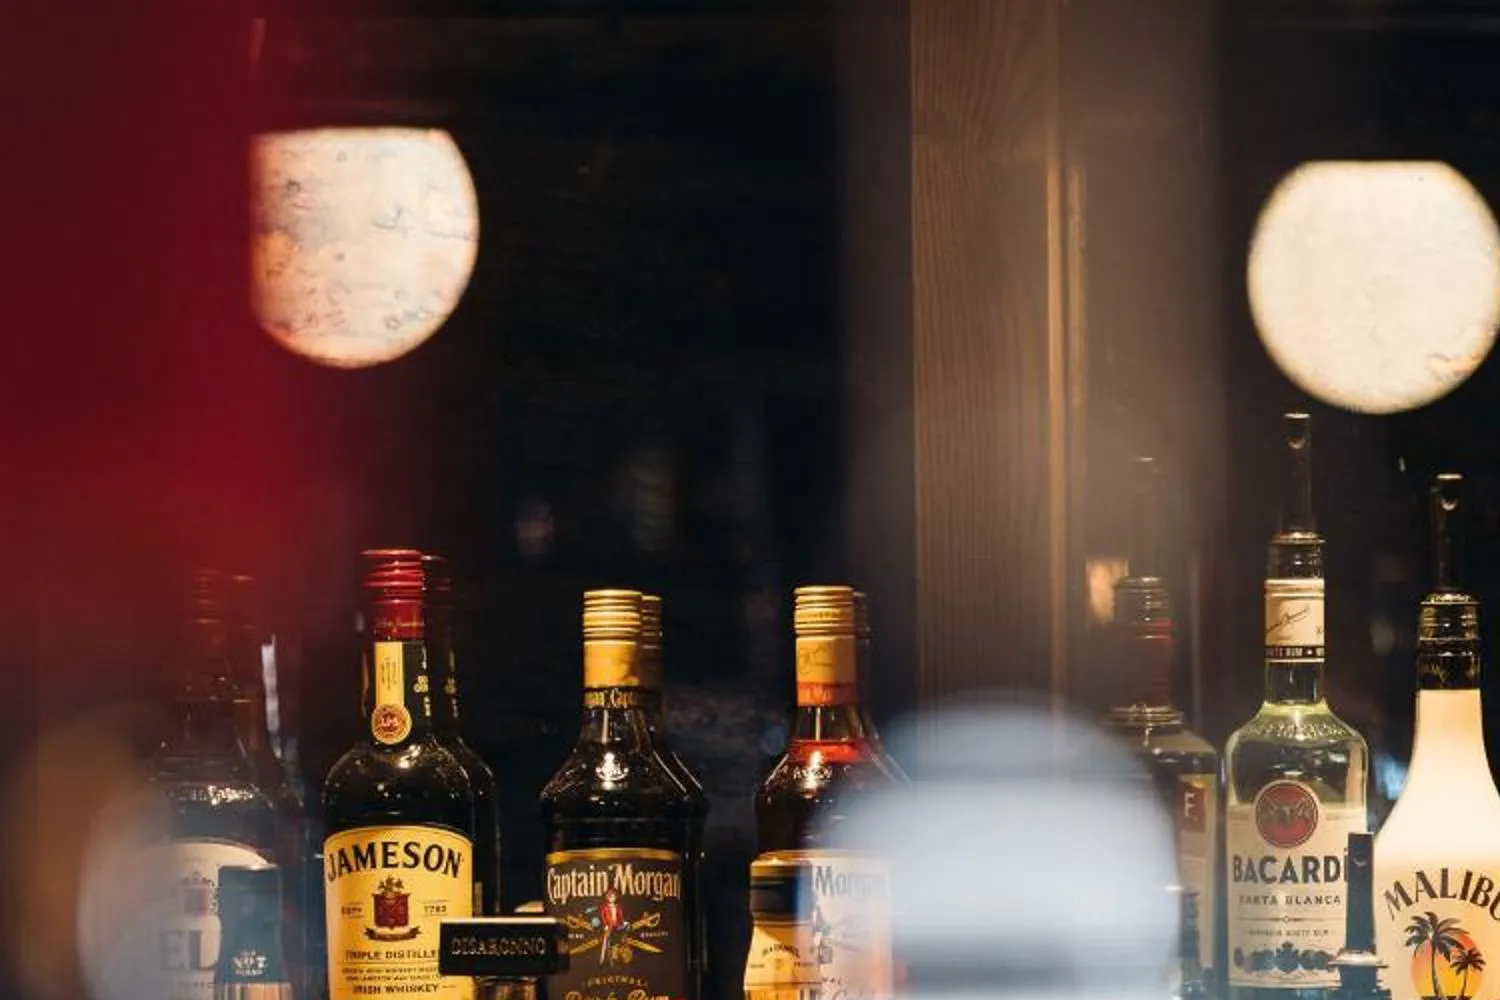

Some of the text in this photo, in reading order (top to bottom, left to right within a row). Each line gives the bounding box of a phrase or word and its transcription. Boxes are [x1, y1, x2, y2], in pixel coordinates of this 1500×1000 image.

[327, 841, 462, 882] JAMESON
[547, 864, 681, 904] Captain Morgan
[451, 937, 546, 956] DISARONNO
[352, 982, 440, 995] IRISH WHISKEY
